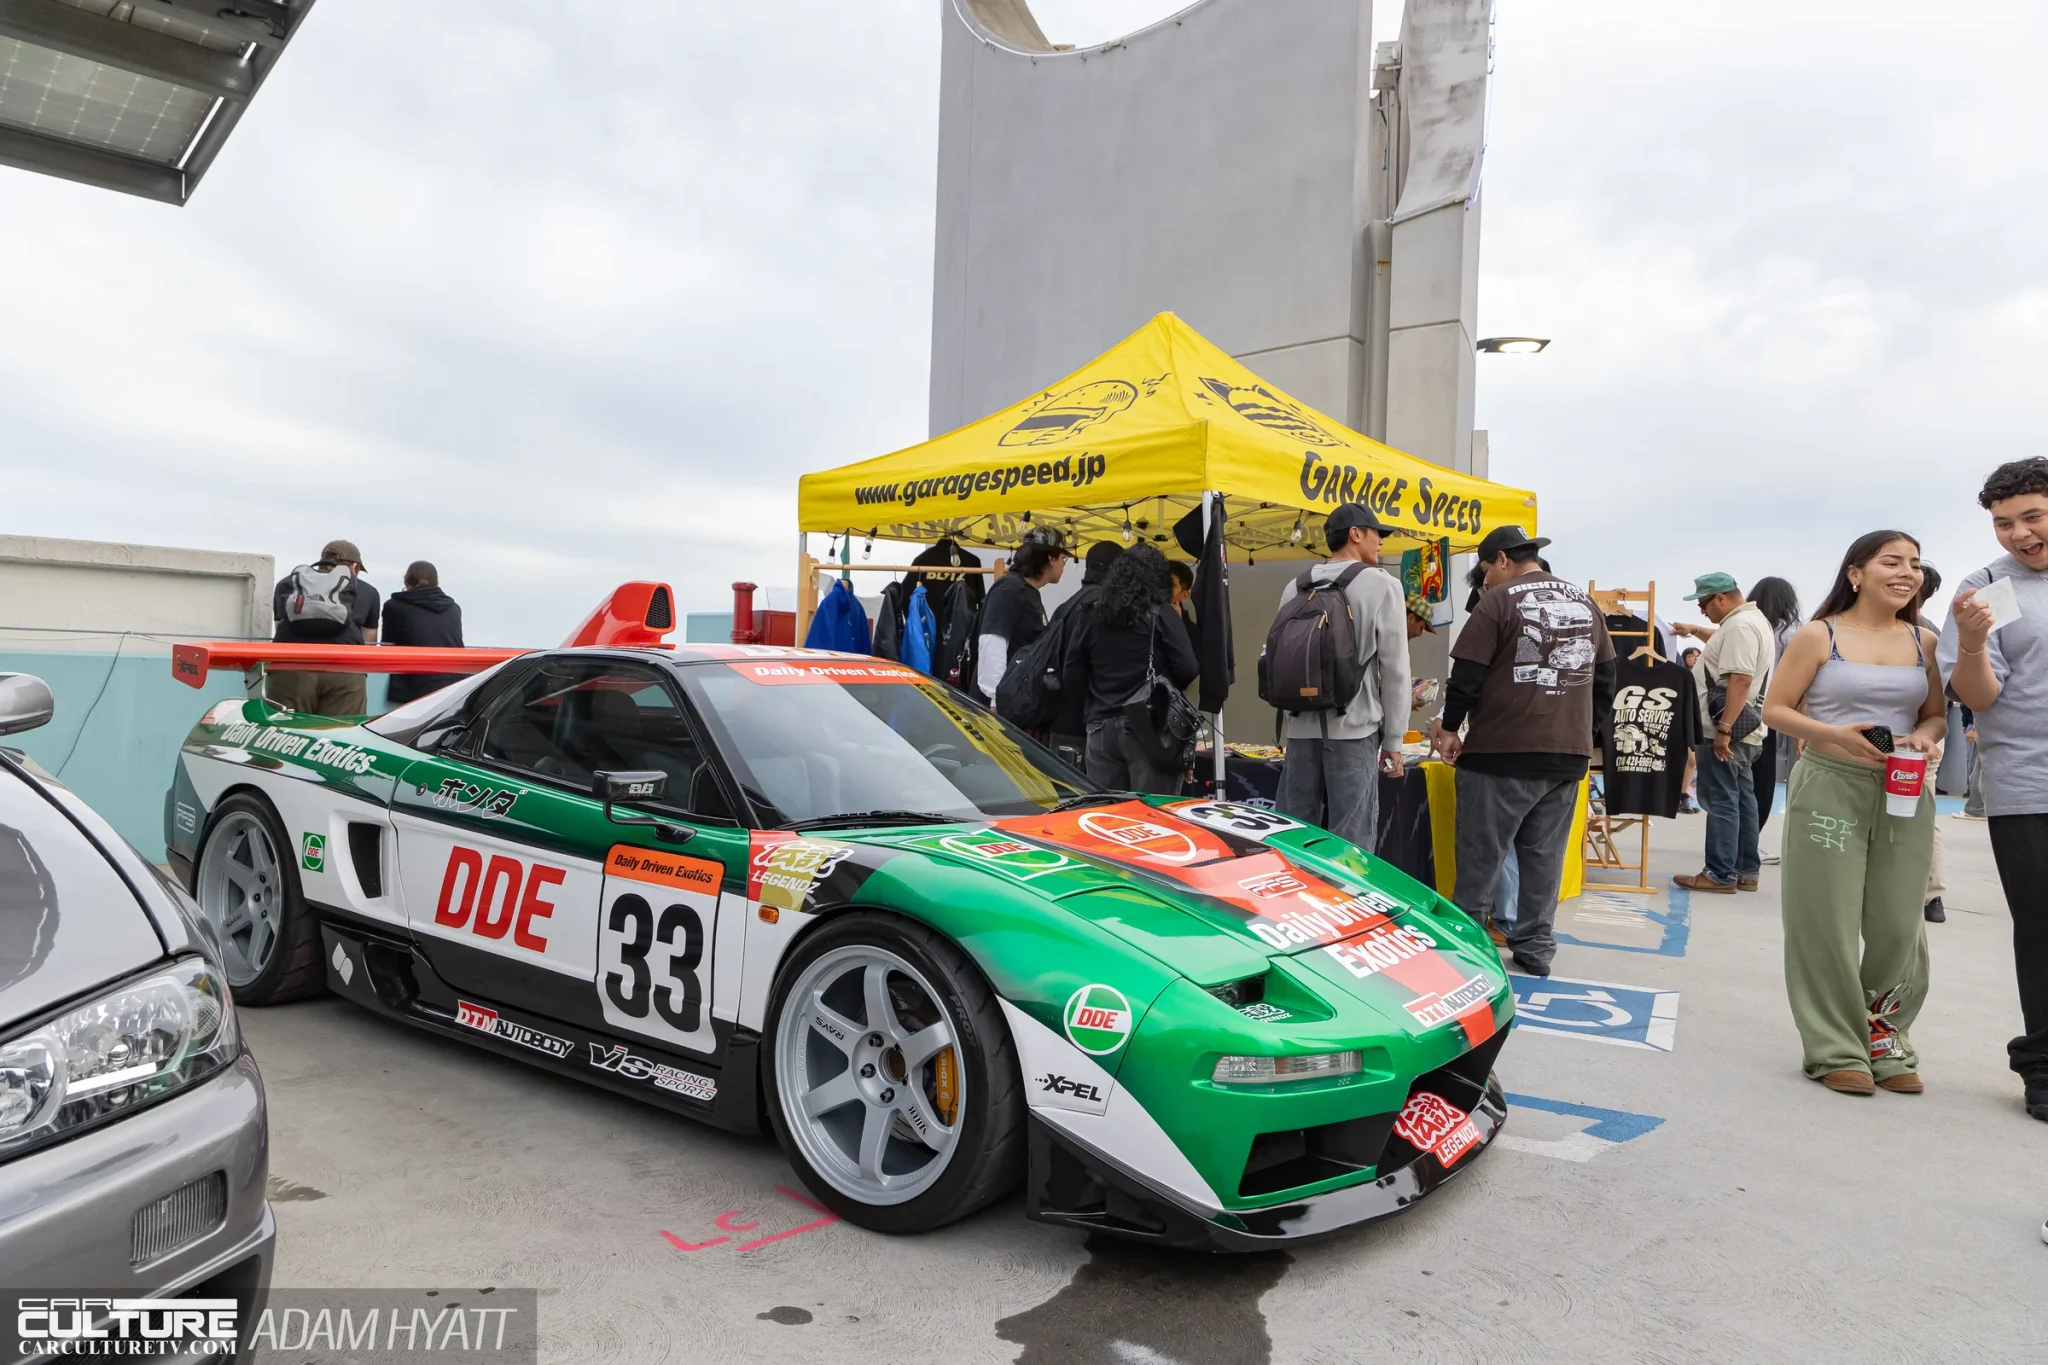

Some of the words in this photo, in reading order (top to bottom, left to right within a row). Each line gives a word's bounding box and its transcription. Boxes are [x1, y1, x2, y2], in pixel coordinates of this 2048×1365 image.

[855, 452, 1106, 506] www.garagespeed.jp
[1300, 450, 1408, 517] GARAGE
[1413, 477, 1482, 535] SPEED
[754, 665, 805, 678] Daily
[809, 665, 867, 677] Driven
[869, 667, 920, 679] Exotics
[1612, 685, 1678, 711] GS
[1614, 708, 1636, 723] AUTO
[1637, 709, 1674, 725] SERVICE
[220, 720, 259, 749] Daily
[254, 726, 309, 756] Driven
[303, 737, 377, 774] Exotics
[1891, 769, 1919, 782] Cane's
[432, 778, 528, 819] ホンダ
[1115, 824, 1162, 844] DDE
[975, 841, 1031, 855] DDE
[614, 854, 640, 871] Daily
[640, 859, 674, 876] Driven
[675, 865, 714, 883] Exotics
[751, 869, 821, 894] LEGENDZ
[434, 845, 567, 954] DDE
[1247, 911, 1342, 950] Daily
[1297, 891, 1398, 927] Driven
[605, 893, 704, 1033] 33
[1322, 924, 1437, 979] Exotics
[815, 1016, 845, 1041] RAYS
[1077, 1008, 1118, 1029] DDE
[655, 1063, 711, 1087] RACING
[655, 1076, 716, 1100] SPORTS
[1041, 1073, 1102, 1102] XPEL
[1436, 1121, 1480, 1164] LEGENDZ
